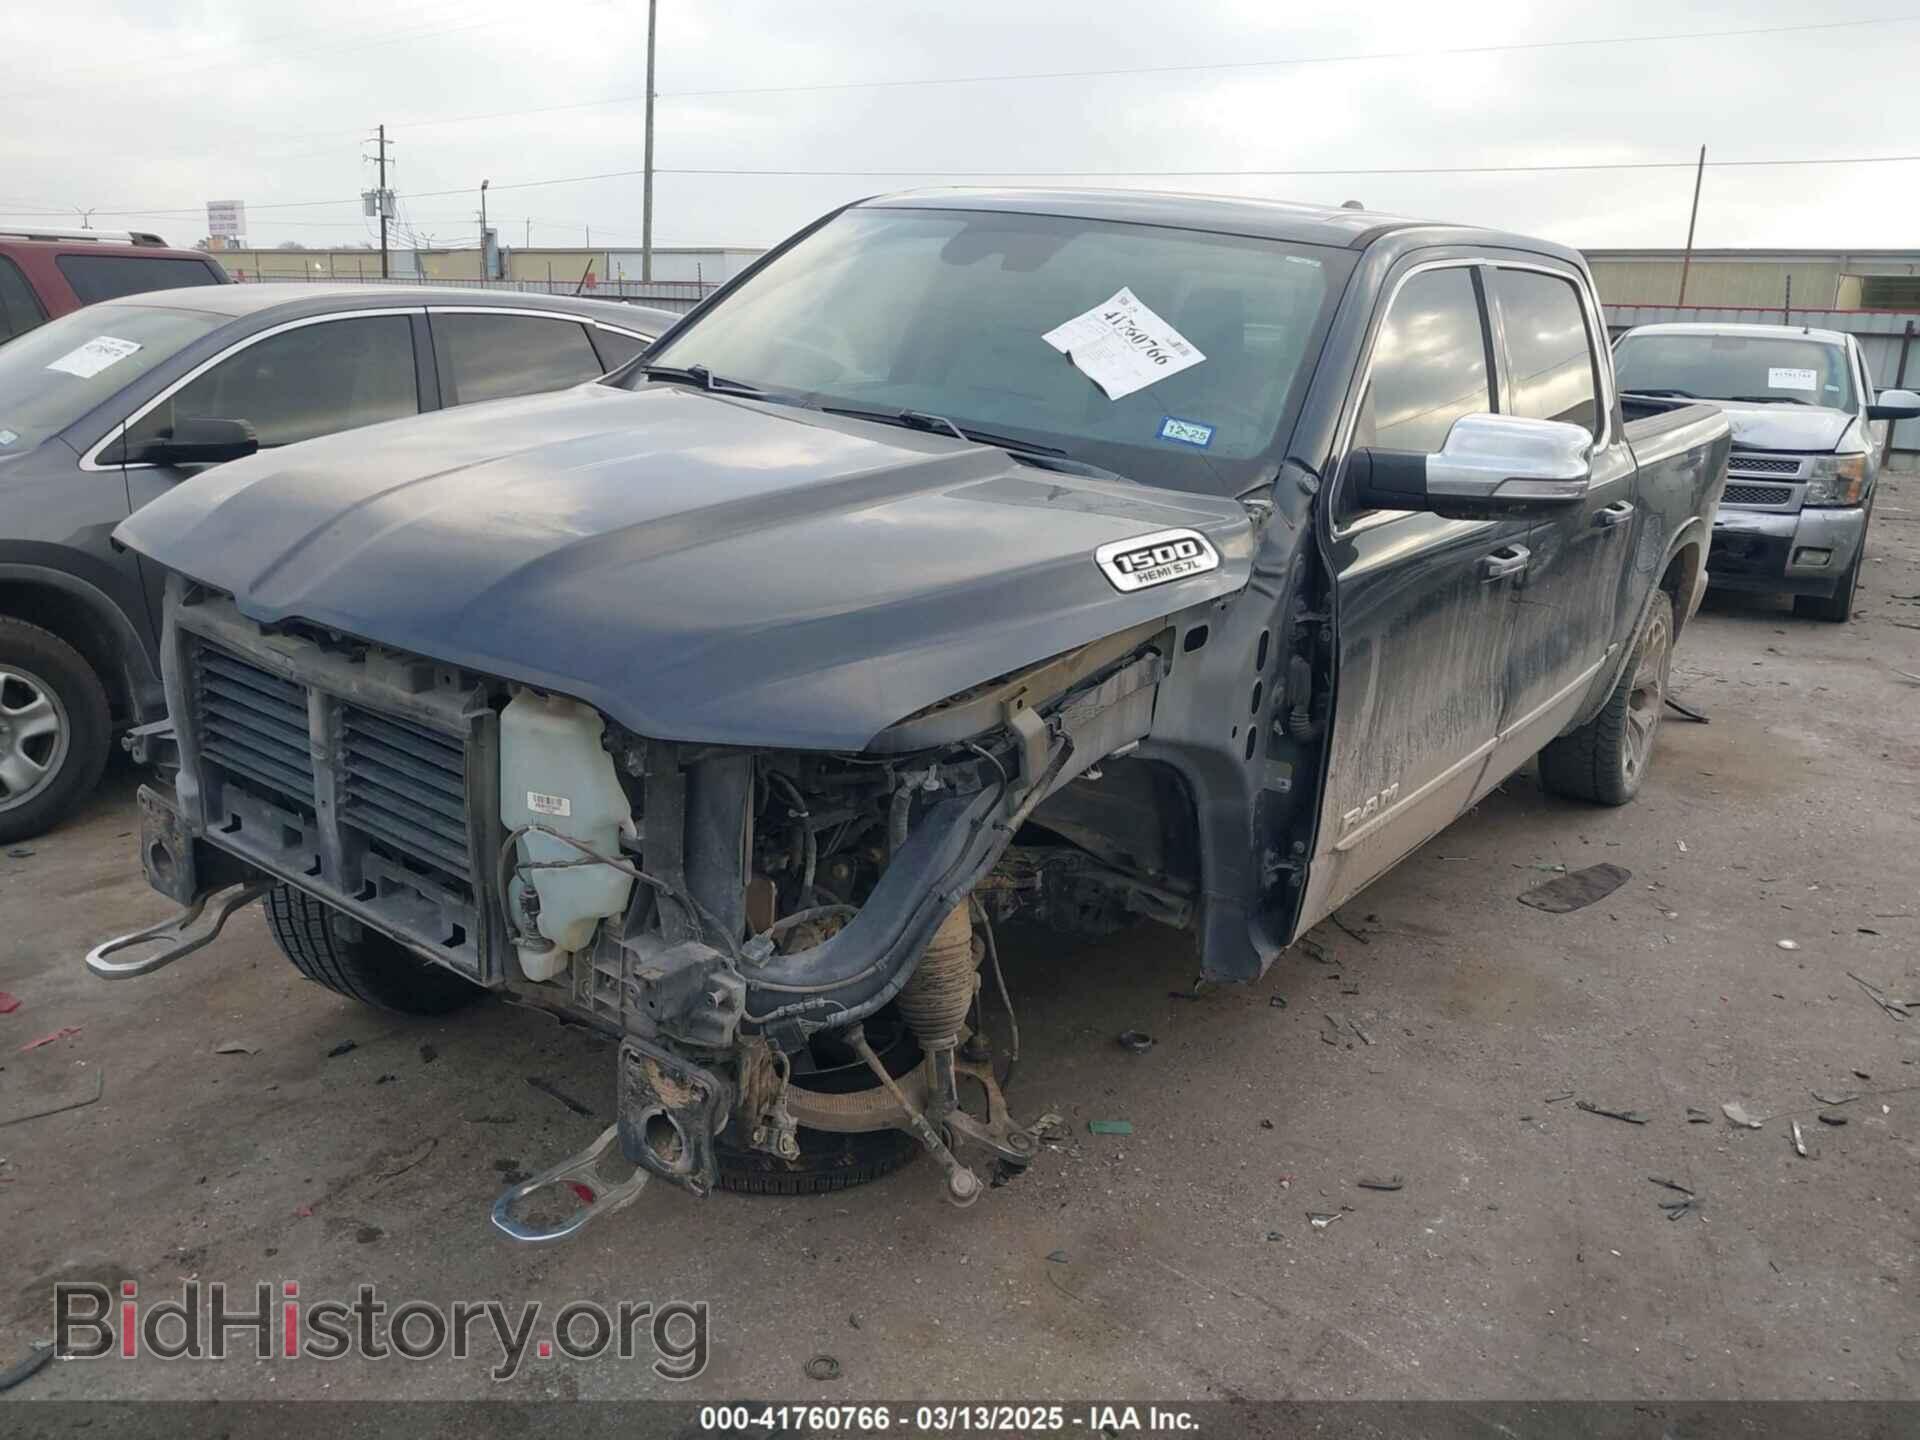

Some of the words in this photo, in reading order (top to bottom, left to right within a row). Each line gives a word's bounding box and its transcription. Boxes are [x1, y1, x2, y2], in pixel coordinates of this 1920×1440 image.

[1103, 311, 1173, 366] 41760766
[1115, 540, 1198, 573] 1500
[1137, 567, 1172, 583] HEMI
[1173, 560, 1201, 575] 5.7L
[1341, 781, 1400, 830] RAM
